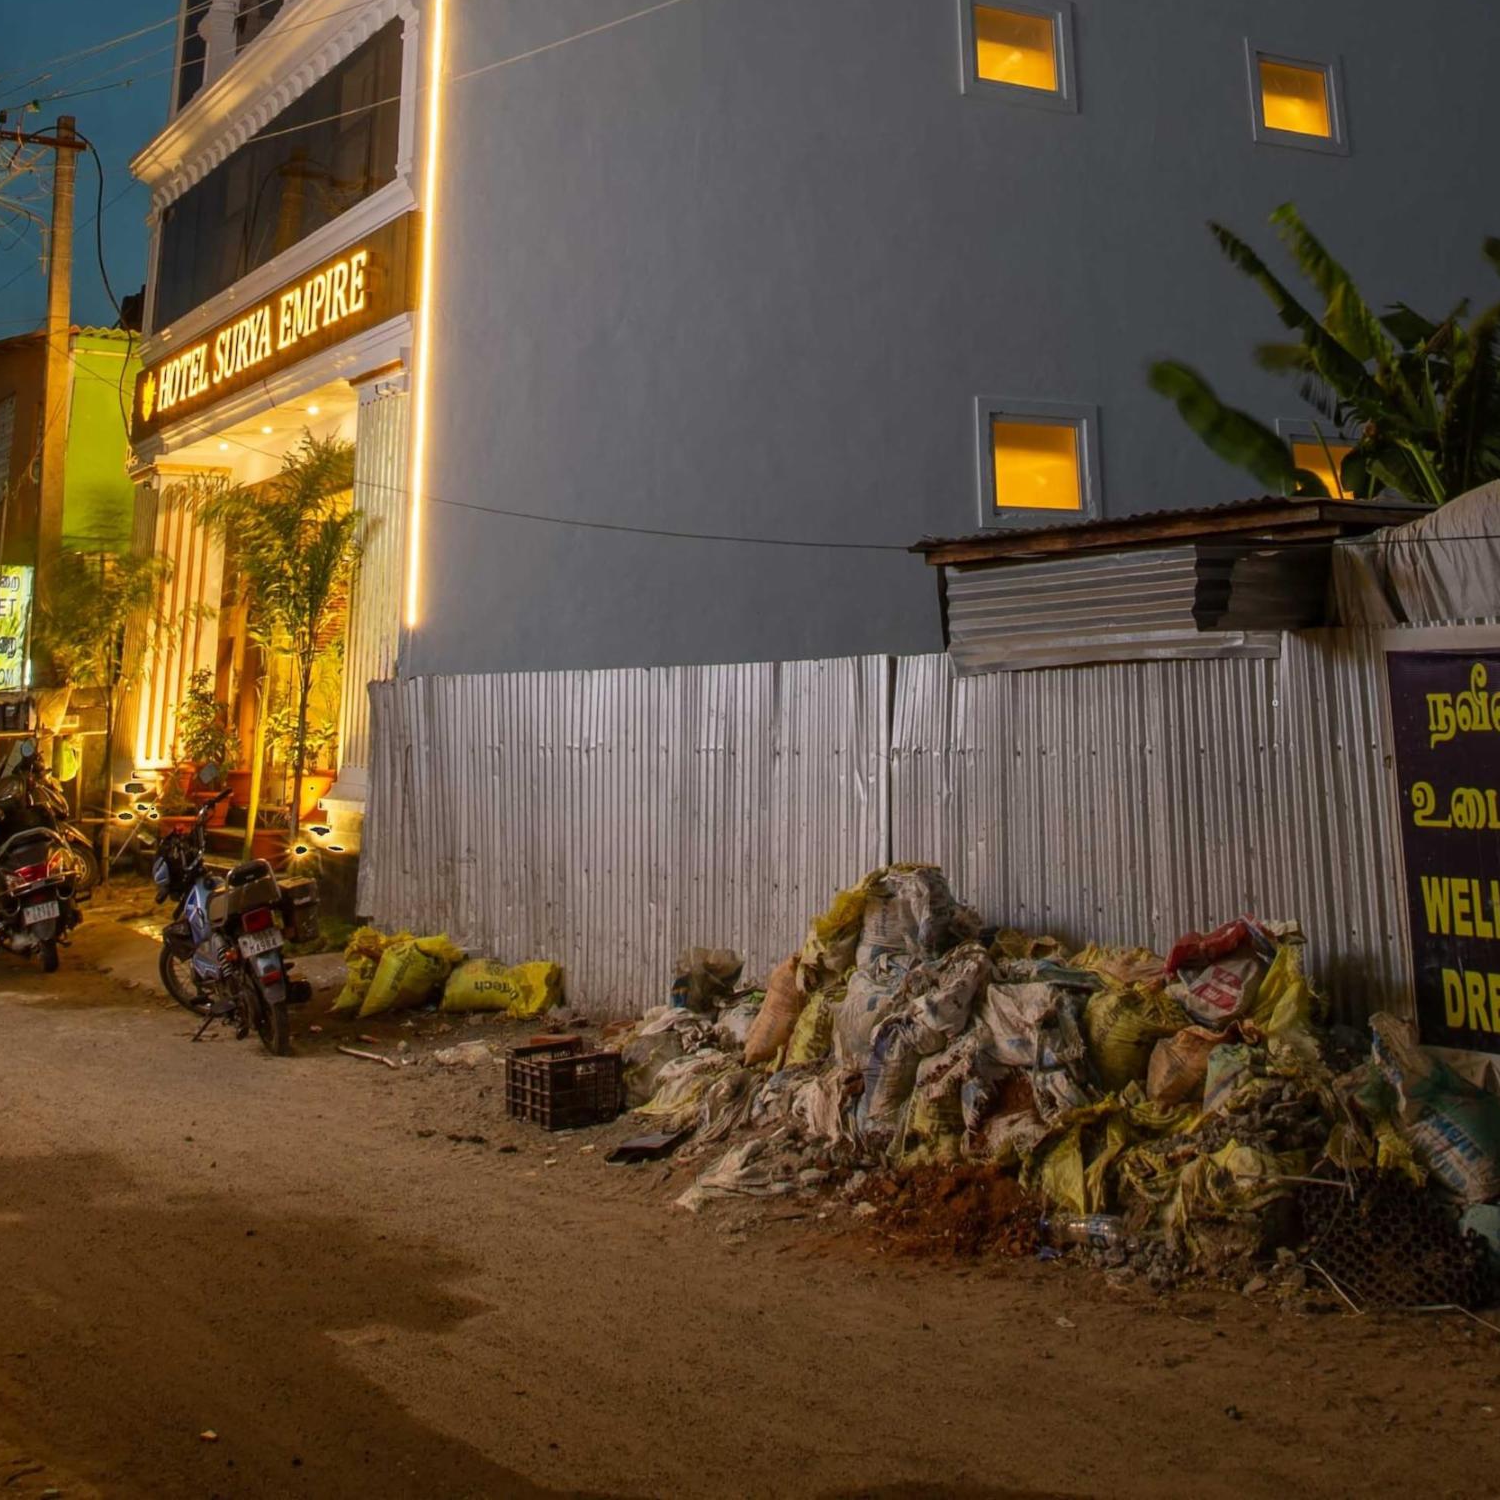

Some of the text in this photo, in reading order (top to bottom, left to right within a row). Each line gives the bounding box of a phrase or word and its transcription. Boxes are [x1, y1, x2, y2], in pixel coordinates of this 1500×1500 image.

[156, 250, 369, 413] HOTEL SURYA EMPIRE
